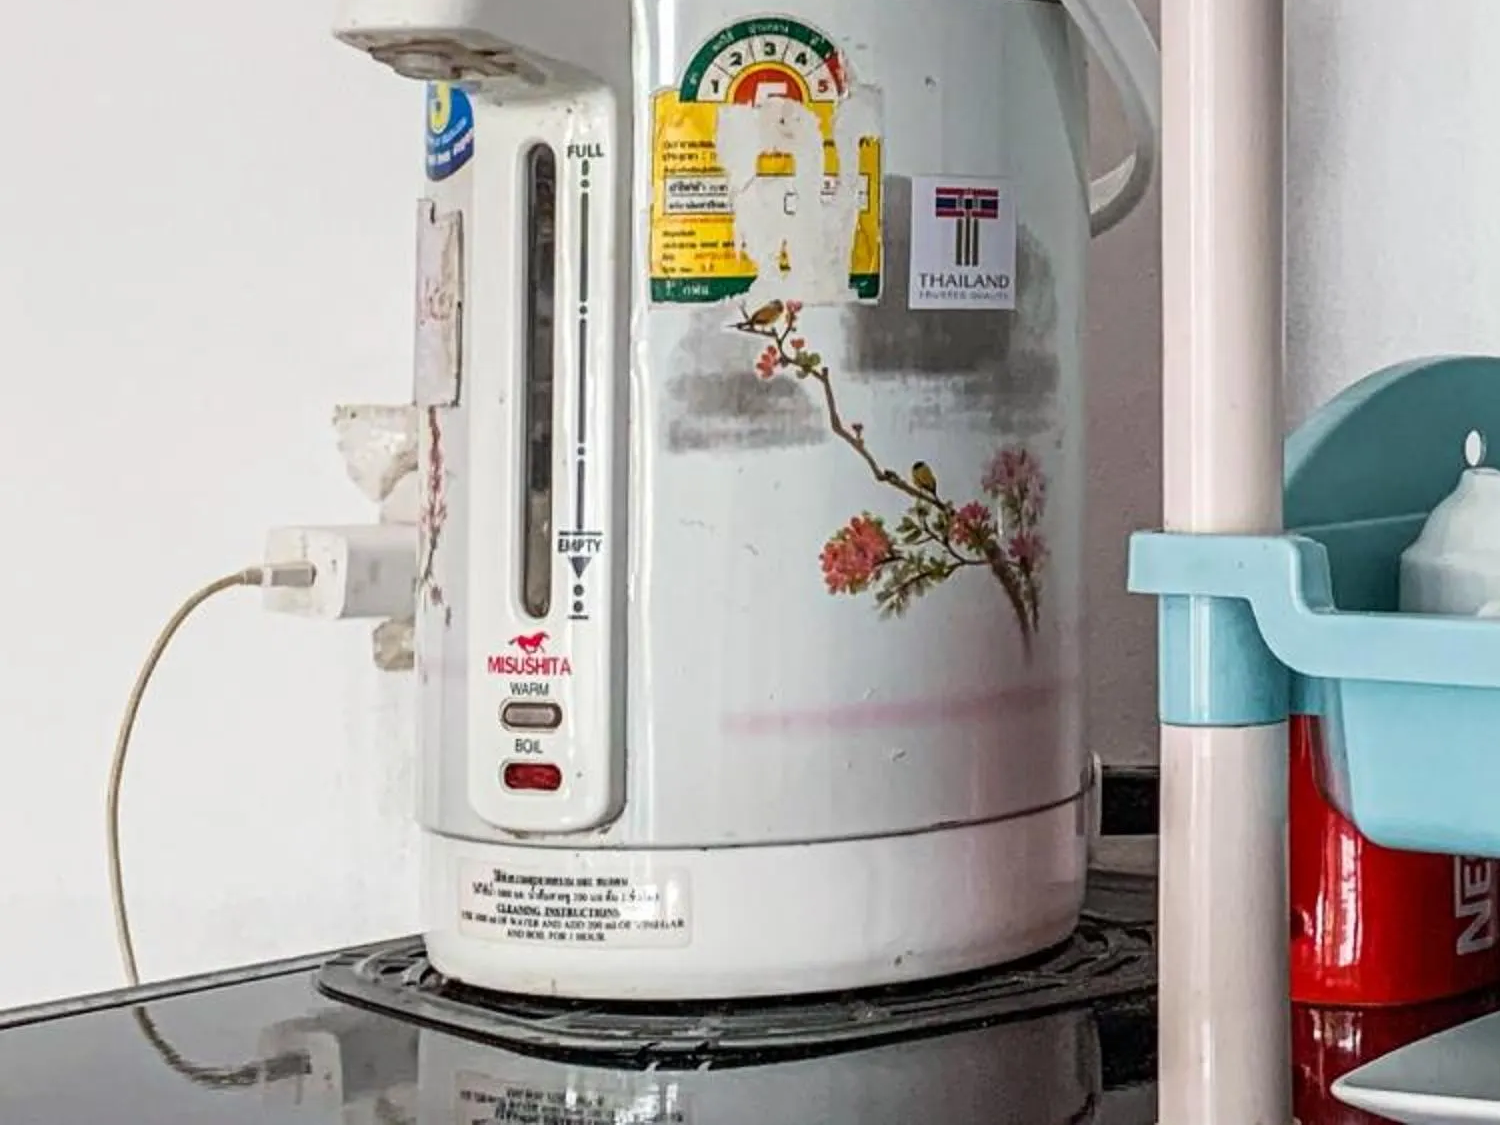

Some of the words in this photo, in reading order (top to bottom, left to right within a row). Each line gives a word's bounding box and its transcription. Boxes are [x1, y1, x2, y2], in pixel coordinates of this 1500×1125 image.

[711, 79, 719, 94] 1
[729, 52, 743, 66] 2
[764, 43, 777, 56] 3
[795, 51, 808, 66] 4
[817, 79, 828, 92] 5
[567, 143, 604, 159] FULL
[919, 273, 1010, 289] THAILAND
[558, 539, 602, 553] EMPTY
[488, 657, 572, 675] MISUSHITA
[510, 683, 549, 696] WARM
[515, 739, 542, 753] BOIL
[496, 903, 541, 916] CLEANING
[545, 906, 621, 918] INSTRUCTIONS
